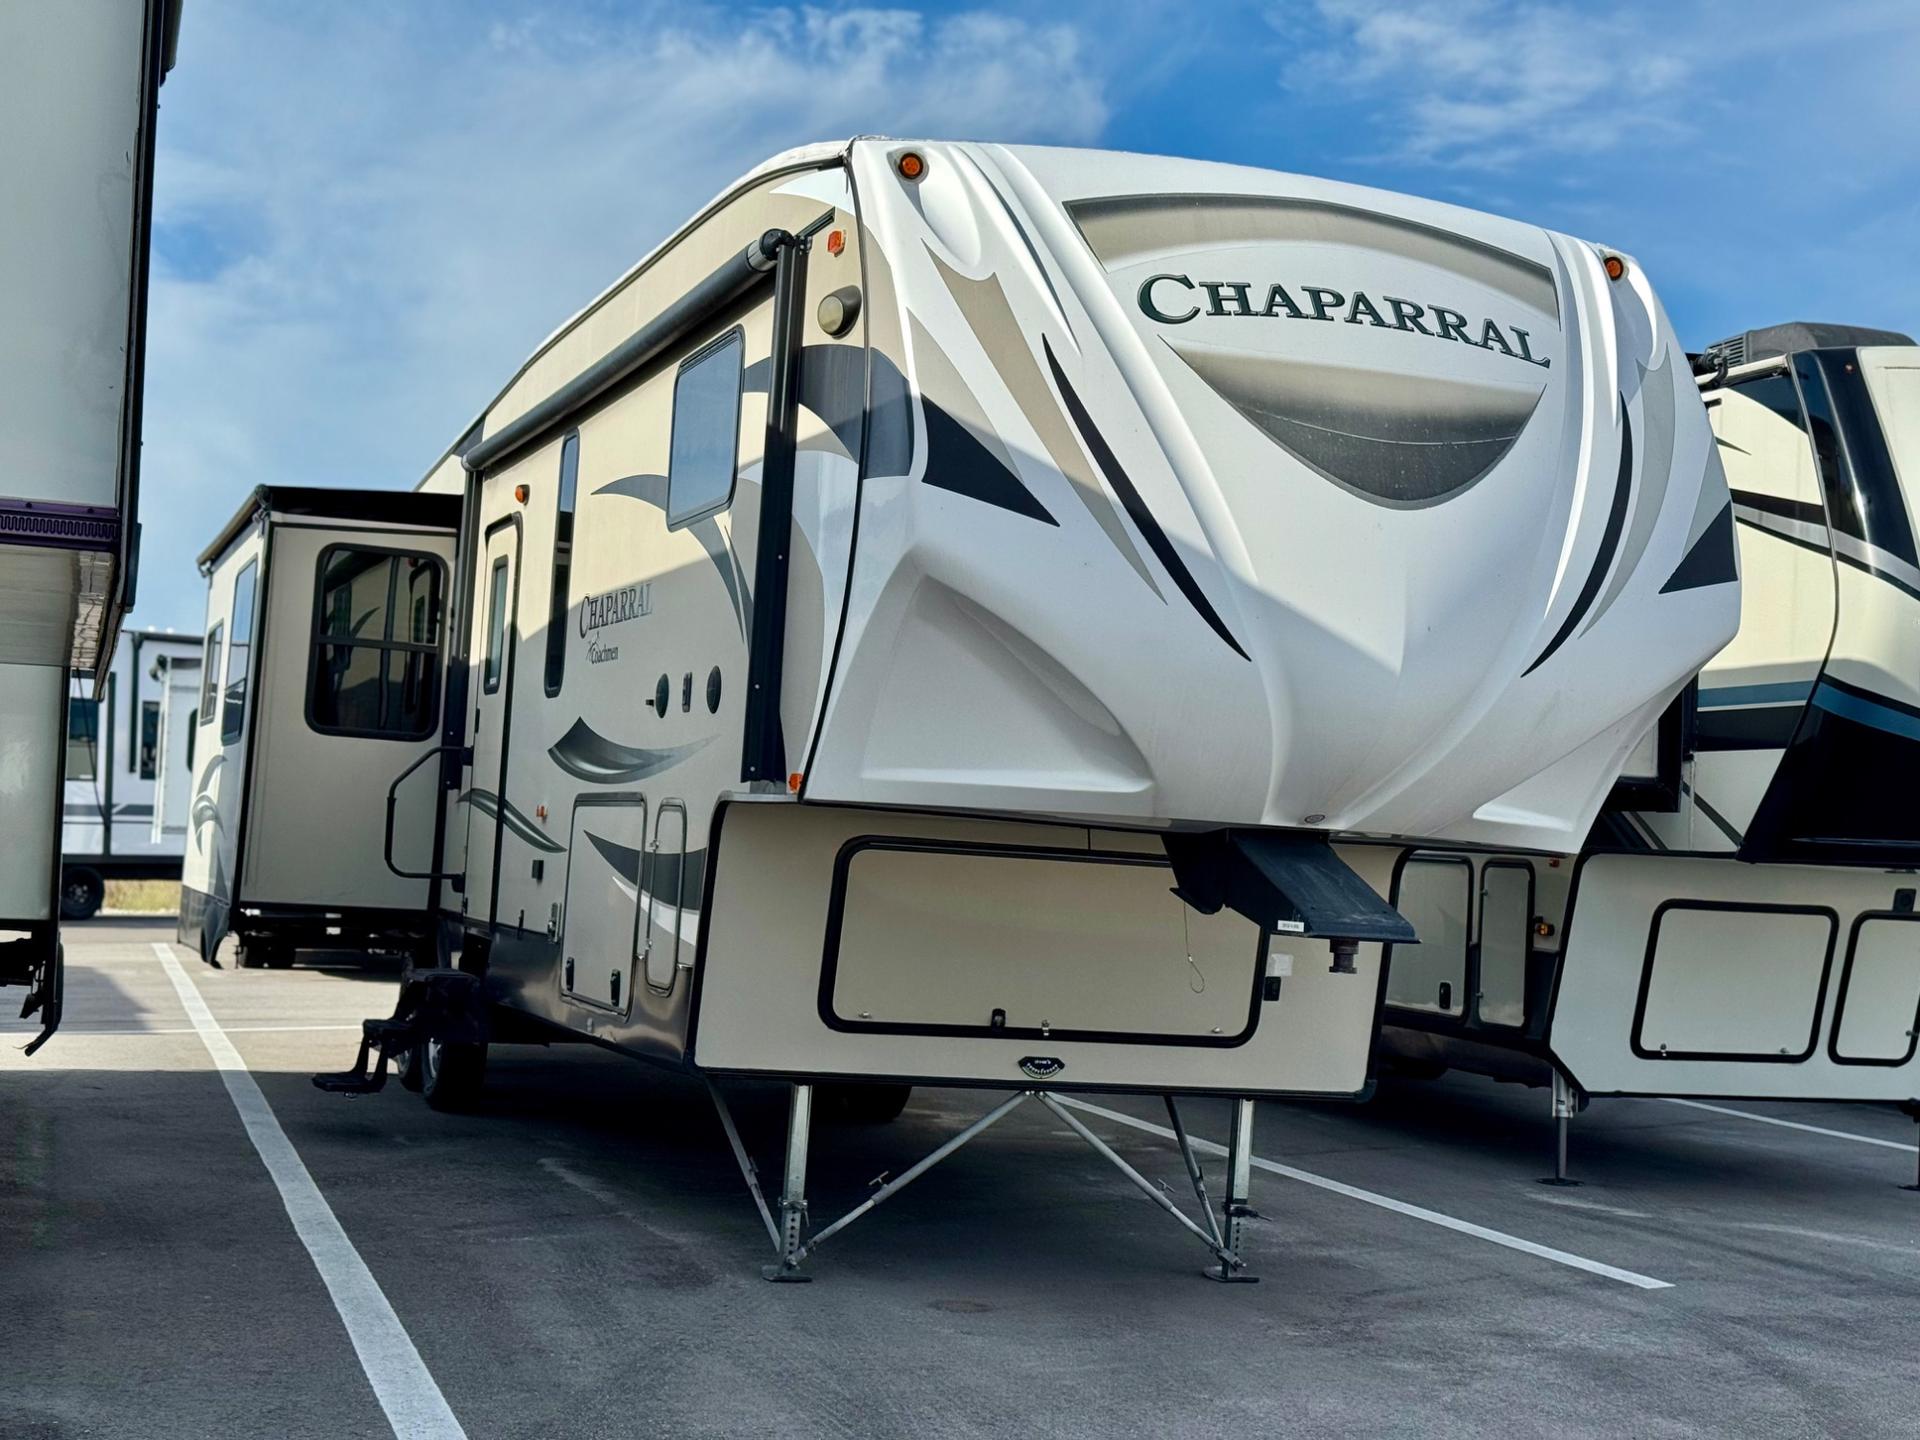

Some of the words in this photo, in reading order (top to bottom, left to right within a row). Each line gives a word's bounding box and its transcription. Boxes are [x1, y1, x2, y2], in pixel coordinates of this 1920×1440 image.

[1138, 274, 1550, 368] CHAPARRAL
[579, 583, 654, 639] CHAPARRAL
[591, 645, 619, 664] Coachmen
